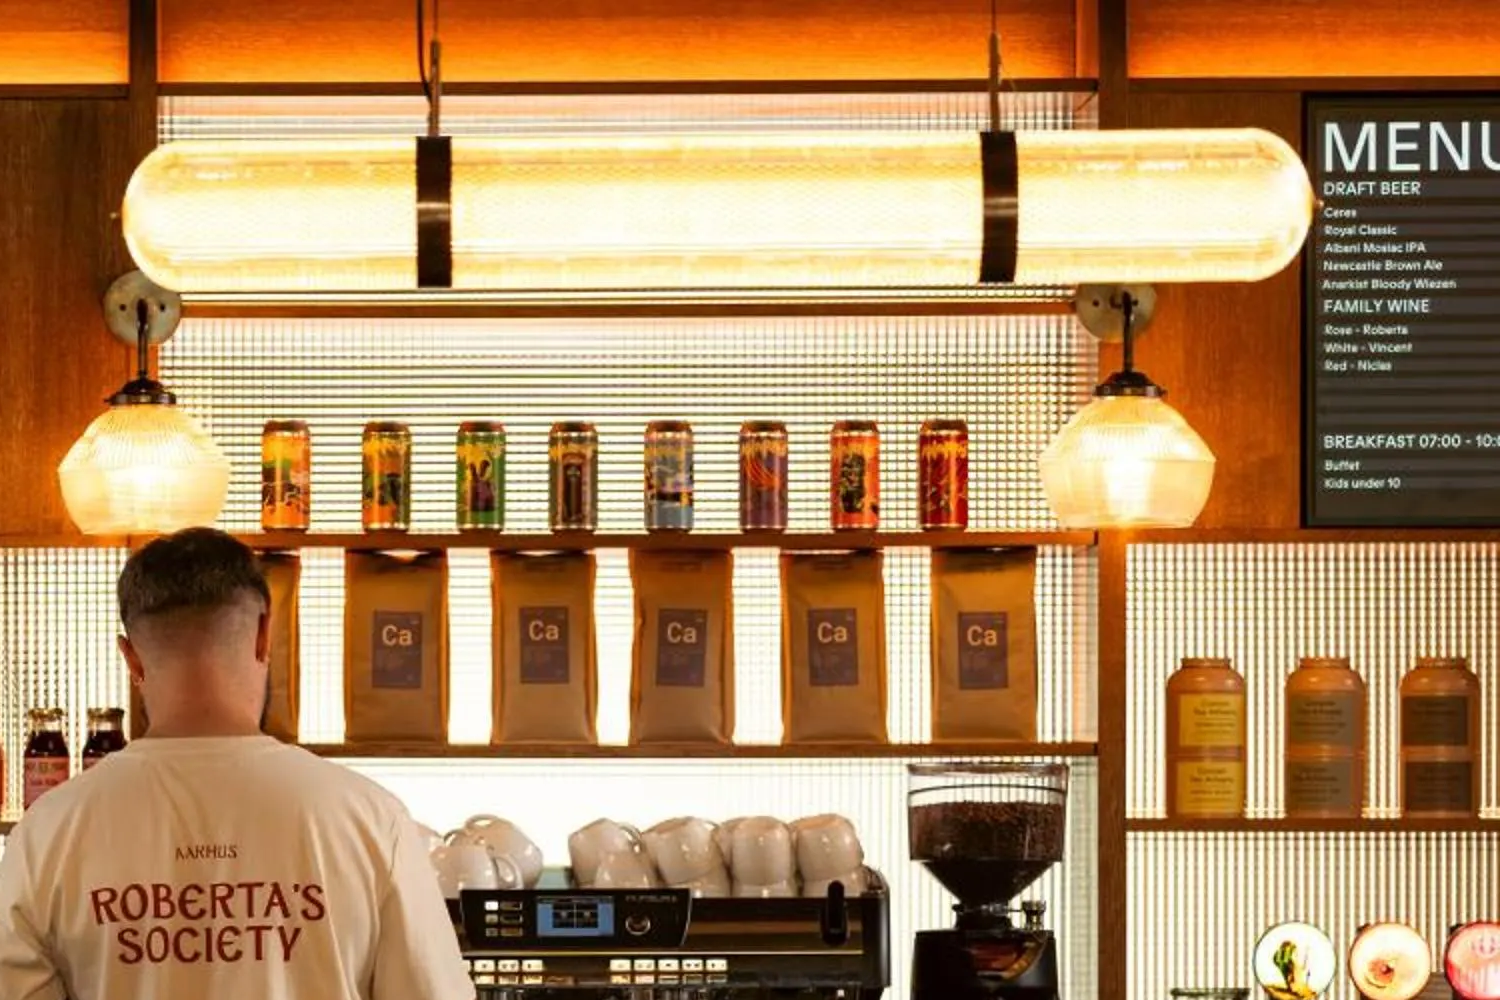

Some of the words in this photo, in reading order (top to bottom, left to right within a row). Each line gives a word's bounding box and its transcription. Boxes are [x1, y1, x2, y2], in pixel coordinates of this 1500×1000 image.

[1324, 181, 1377, 195] DRAFT
[1380, 181, 1421, 195] BEER
[1324, 208, 1357, 218] Ceres
[1324, 225, 1357, 237] Royal
[1359, 225, 1397, 236] Classic
[1324, 243, 1361, 253] Albani
[1405, 241, 1426, 252] IPA
[1323, 260, 1382, 271] Newcastle
[1384, 260, 1421, 271] Brown
[1423, 259, 1443, 270] Ale
[1322, 279, 1369, 290] Anarkist
[1371, 279, 1412, 291] Bloody
[1324, 300, 1383, 313] FAMILY
[1386, 299, 1430, 313] WINE
[1324, 324, 1353, 335] Rose
[1362, 324, 1409, 335] Roberta
[1324, 342, 1358, 353] White
[1368, 342, 1413, 353] Vincent
[1324, 360, 1348, 371] Red
[1324, 434, 1416, 449] BREAKFAST
[1419, 433, 1461, 448] 07:00
[1324, 460, 1360, 471] Buffet
[1324, 477, 1349, 489] Kids
[1351, 477, 1385, 489] under
[1388, 477, 1401, 488] 10
[381, 625, 413, 646] Ca
[528, 620, 559, 641] Ca
[667, 622, 698, 644] Ca
[817, 622, 848, 644] Ca
[966, 625, 998, 646] Ca
[175, 844, 238, 861] AARHUS
[90, 881, 326, 925] ROBERTA'S
[116, 925, 303, 966] SOCIETY
